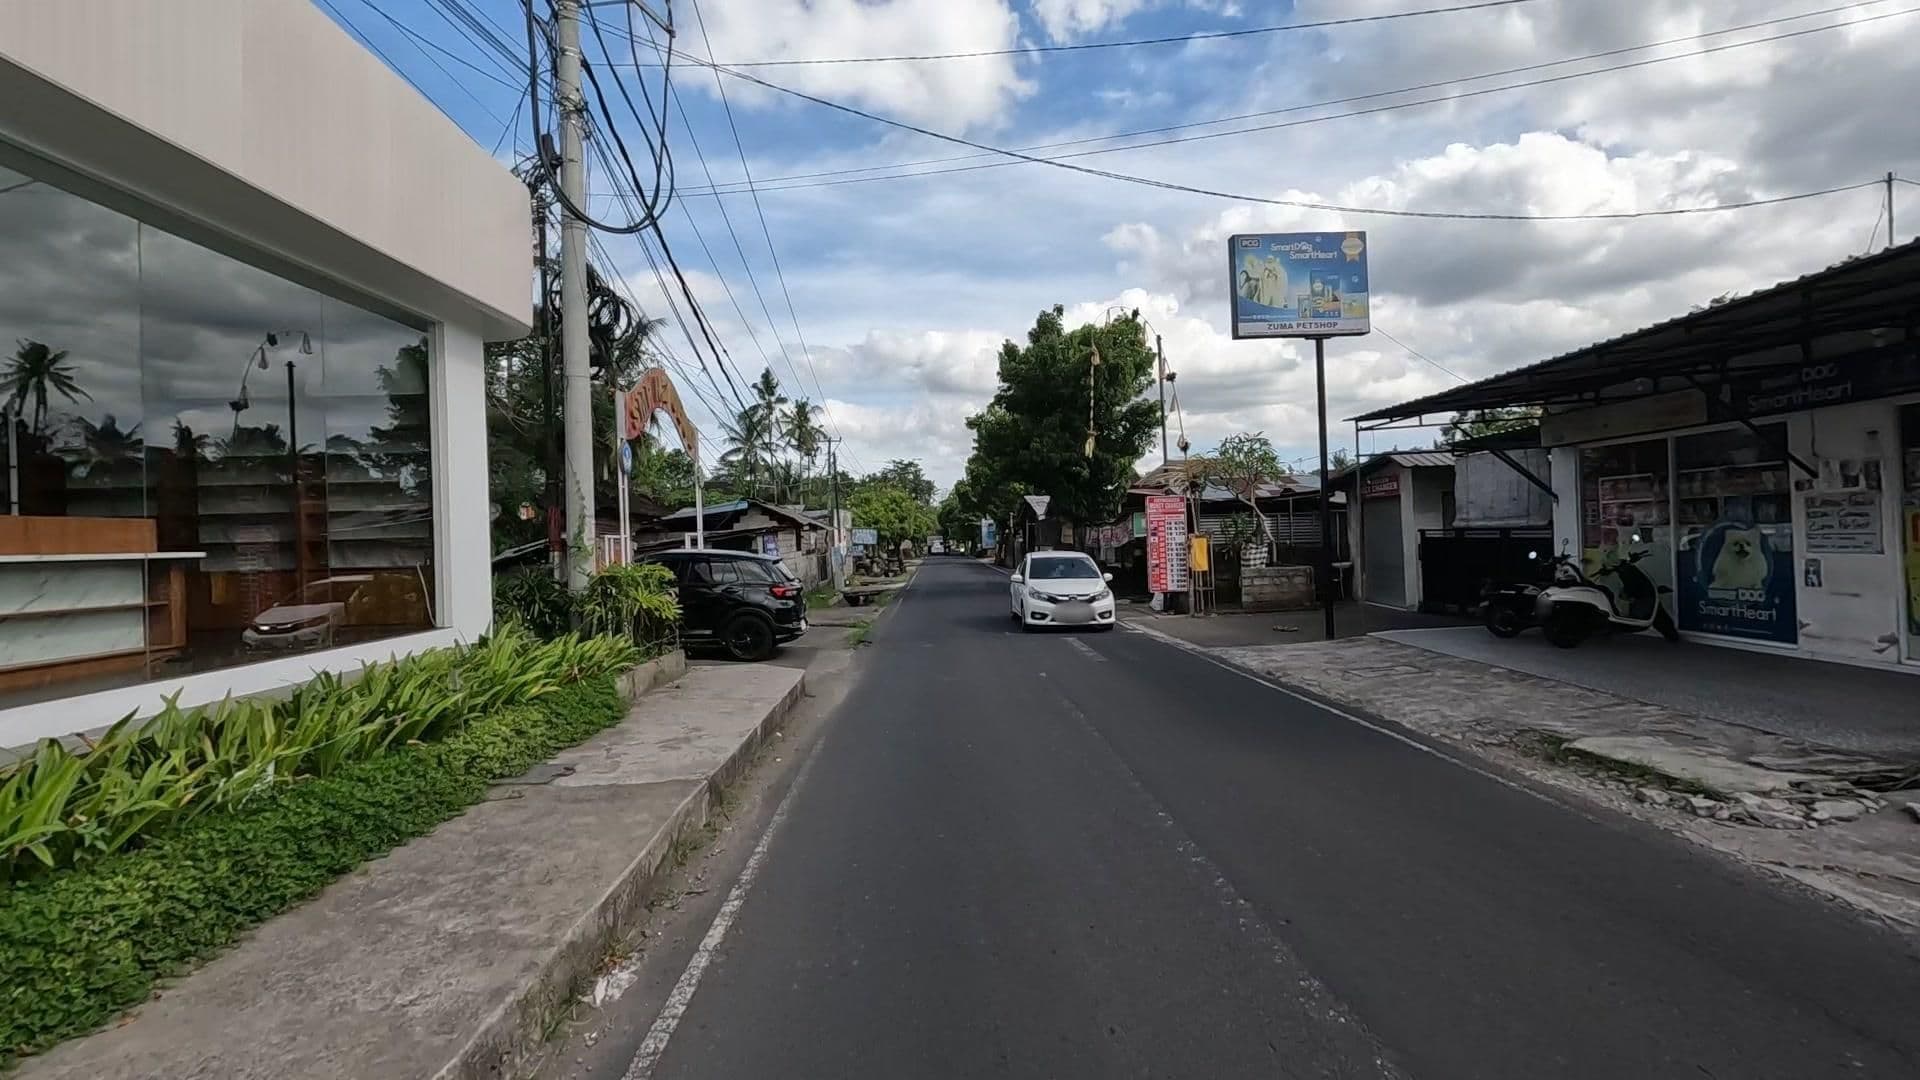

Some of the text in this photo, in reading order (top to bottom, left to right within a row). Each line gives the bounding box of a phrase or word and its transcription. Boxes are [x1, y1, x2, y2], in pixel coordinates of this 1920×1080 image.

[1290, 251, 1337, 259] SmartHeart
[1267, 322, 1338, 330] ZUMA PETSHOP
[1748, 382, 1852, 411] SmartHeart
[1698, 601, 1777, 622] SmartHeart
